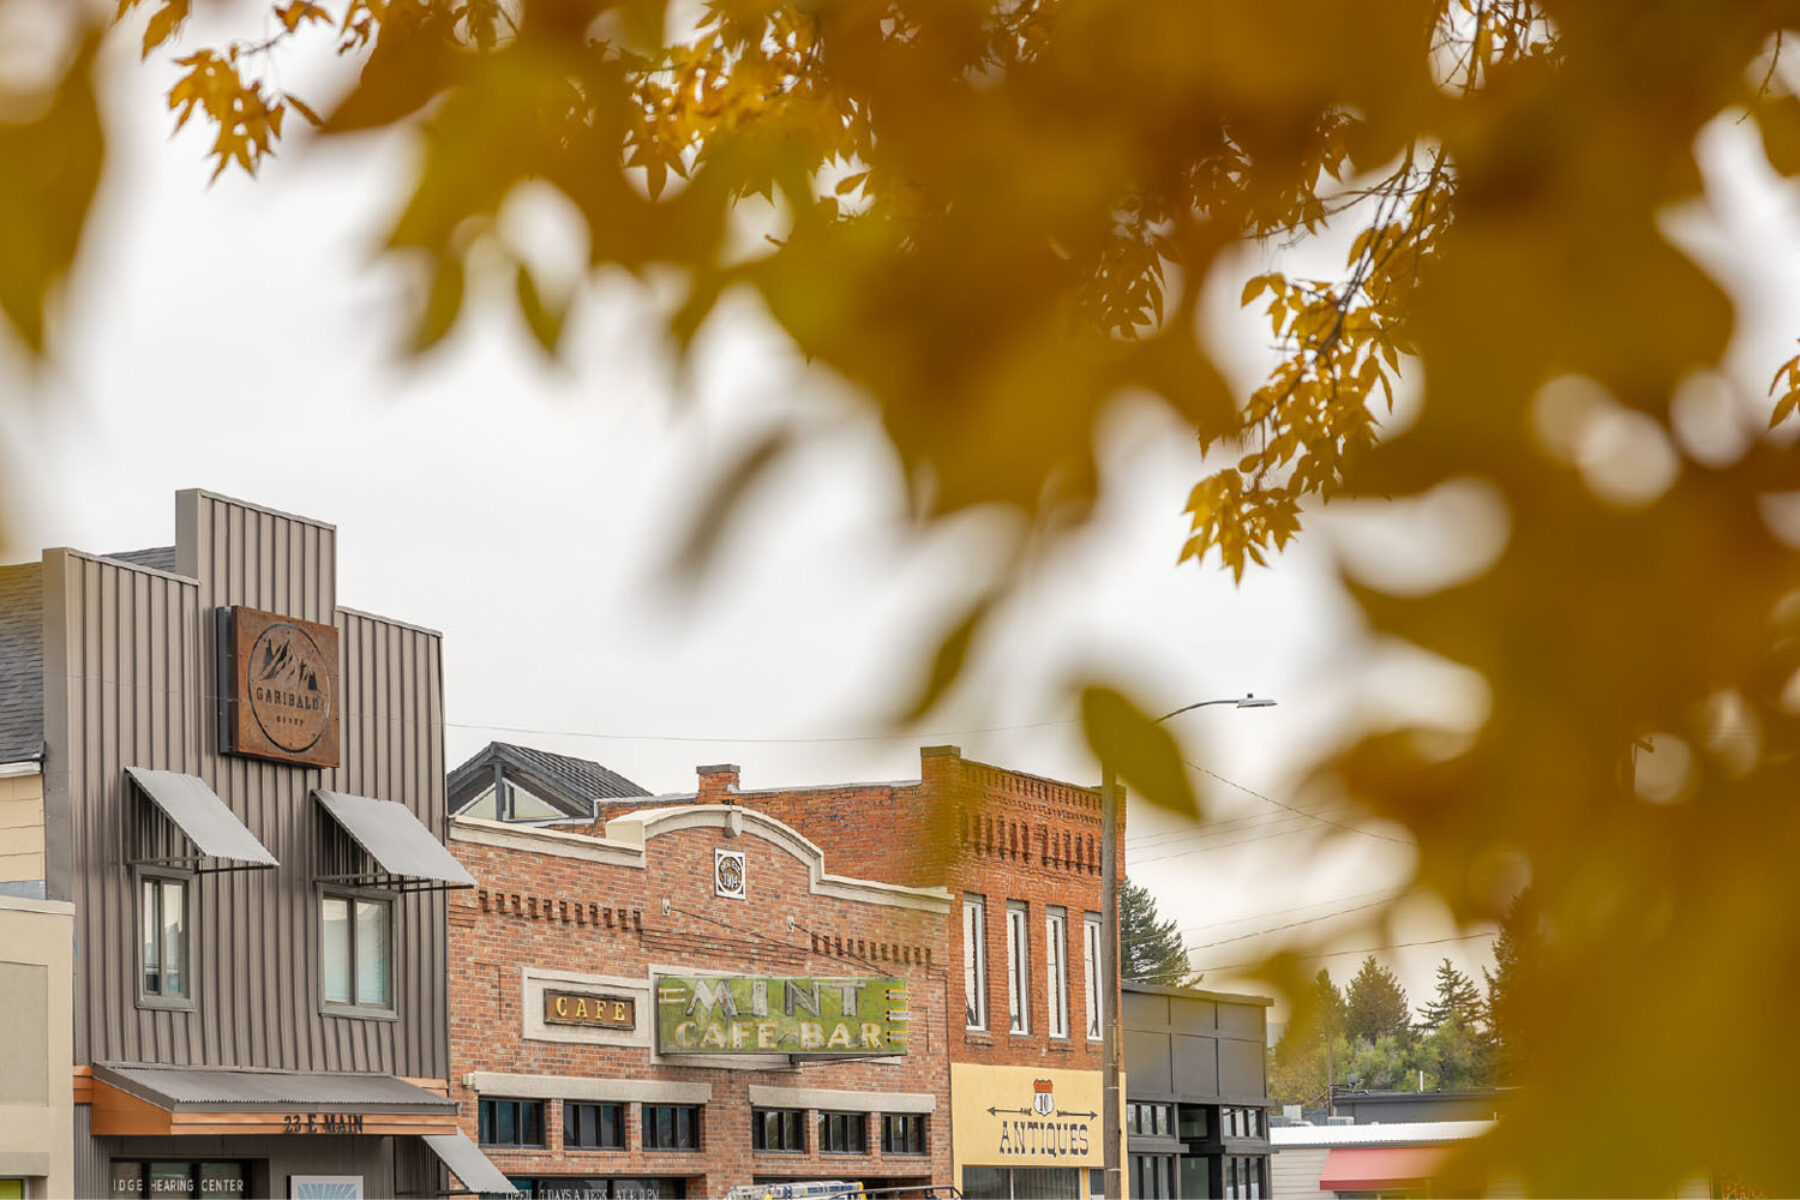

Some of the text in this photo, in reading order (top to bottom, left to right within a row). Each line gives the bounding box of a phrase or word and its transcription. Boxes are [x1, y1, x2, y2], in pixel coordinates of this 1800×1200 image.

[556, 996, 625, 1021] CAFE
[685, 979, 866, 1017] MINT
[675, 1020, 884, 1049] CAFE BAR
[284, 1113, 363, 1134] 23 E MAIN
[999, 1120, 1089, 1158] ANTIQUES
[151, 1179, 194, 1192] HEARING
[201, 1179, 244, 1192] CENTER
[548, 1189, 571, 1200] DAYS
